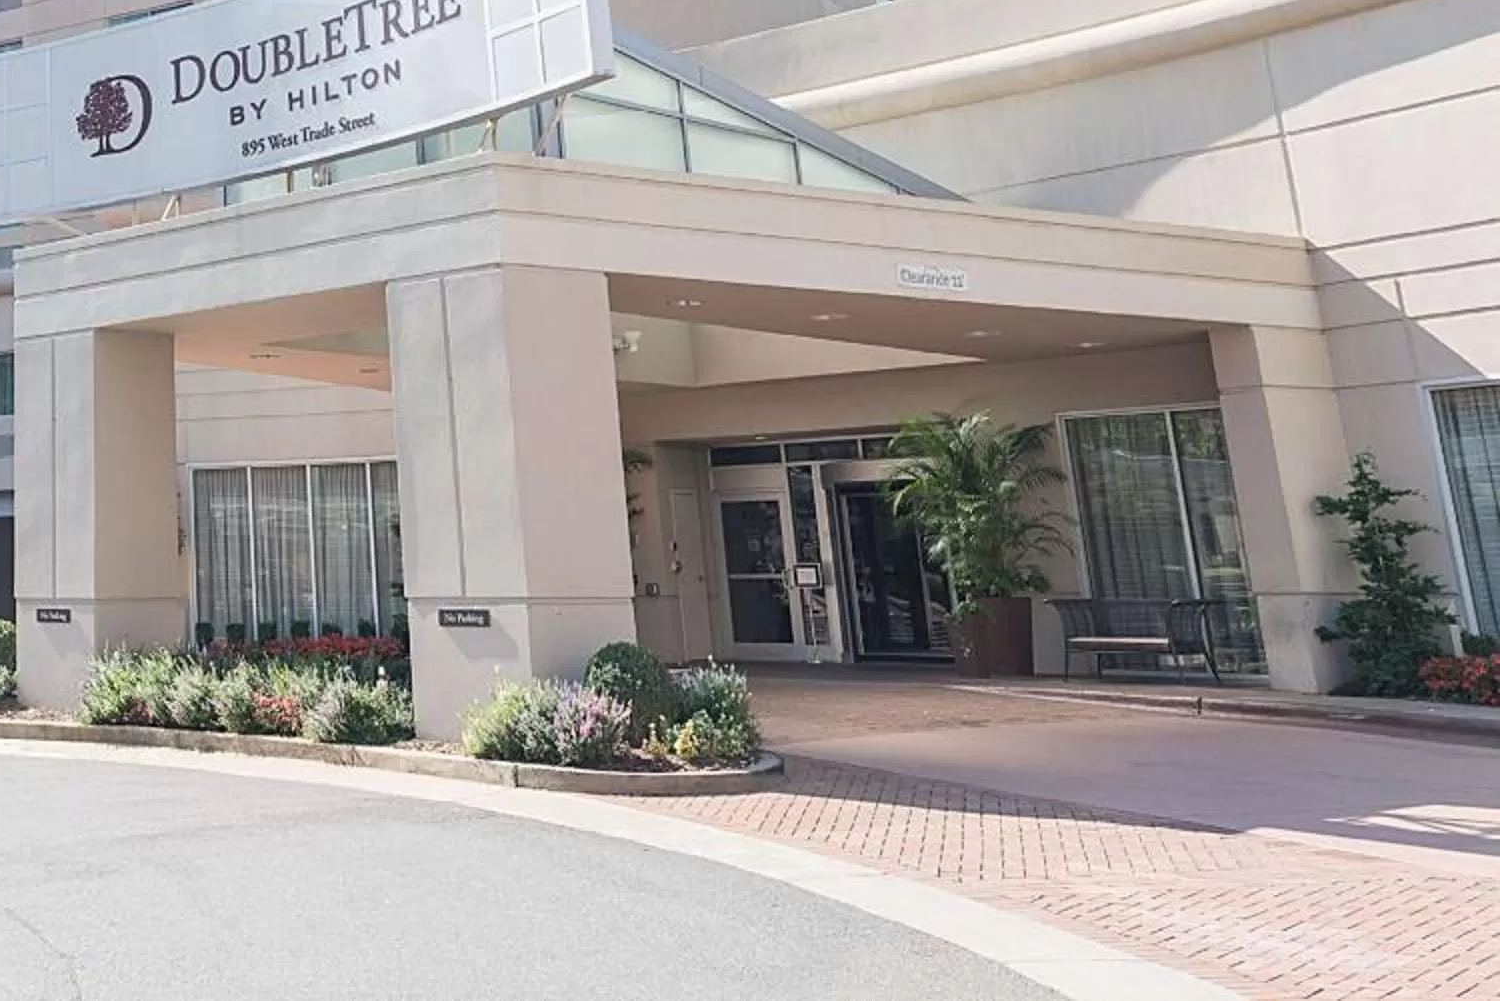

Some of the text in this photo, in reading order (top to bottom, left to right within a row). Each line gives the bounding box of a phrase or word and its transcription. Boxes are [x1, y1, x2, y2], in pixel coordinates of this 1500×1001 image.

[229, 57, 403, 126] BY HILTON
[241, 112, 376, 158] 895 West Trade Street
